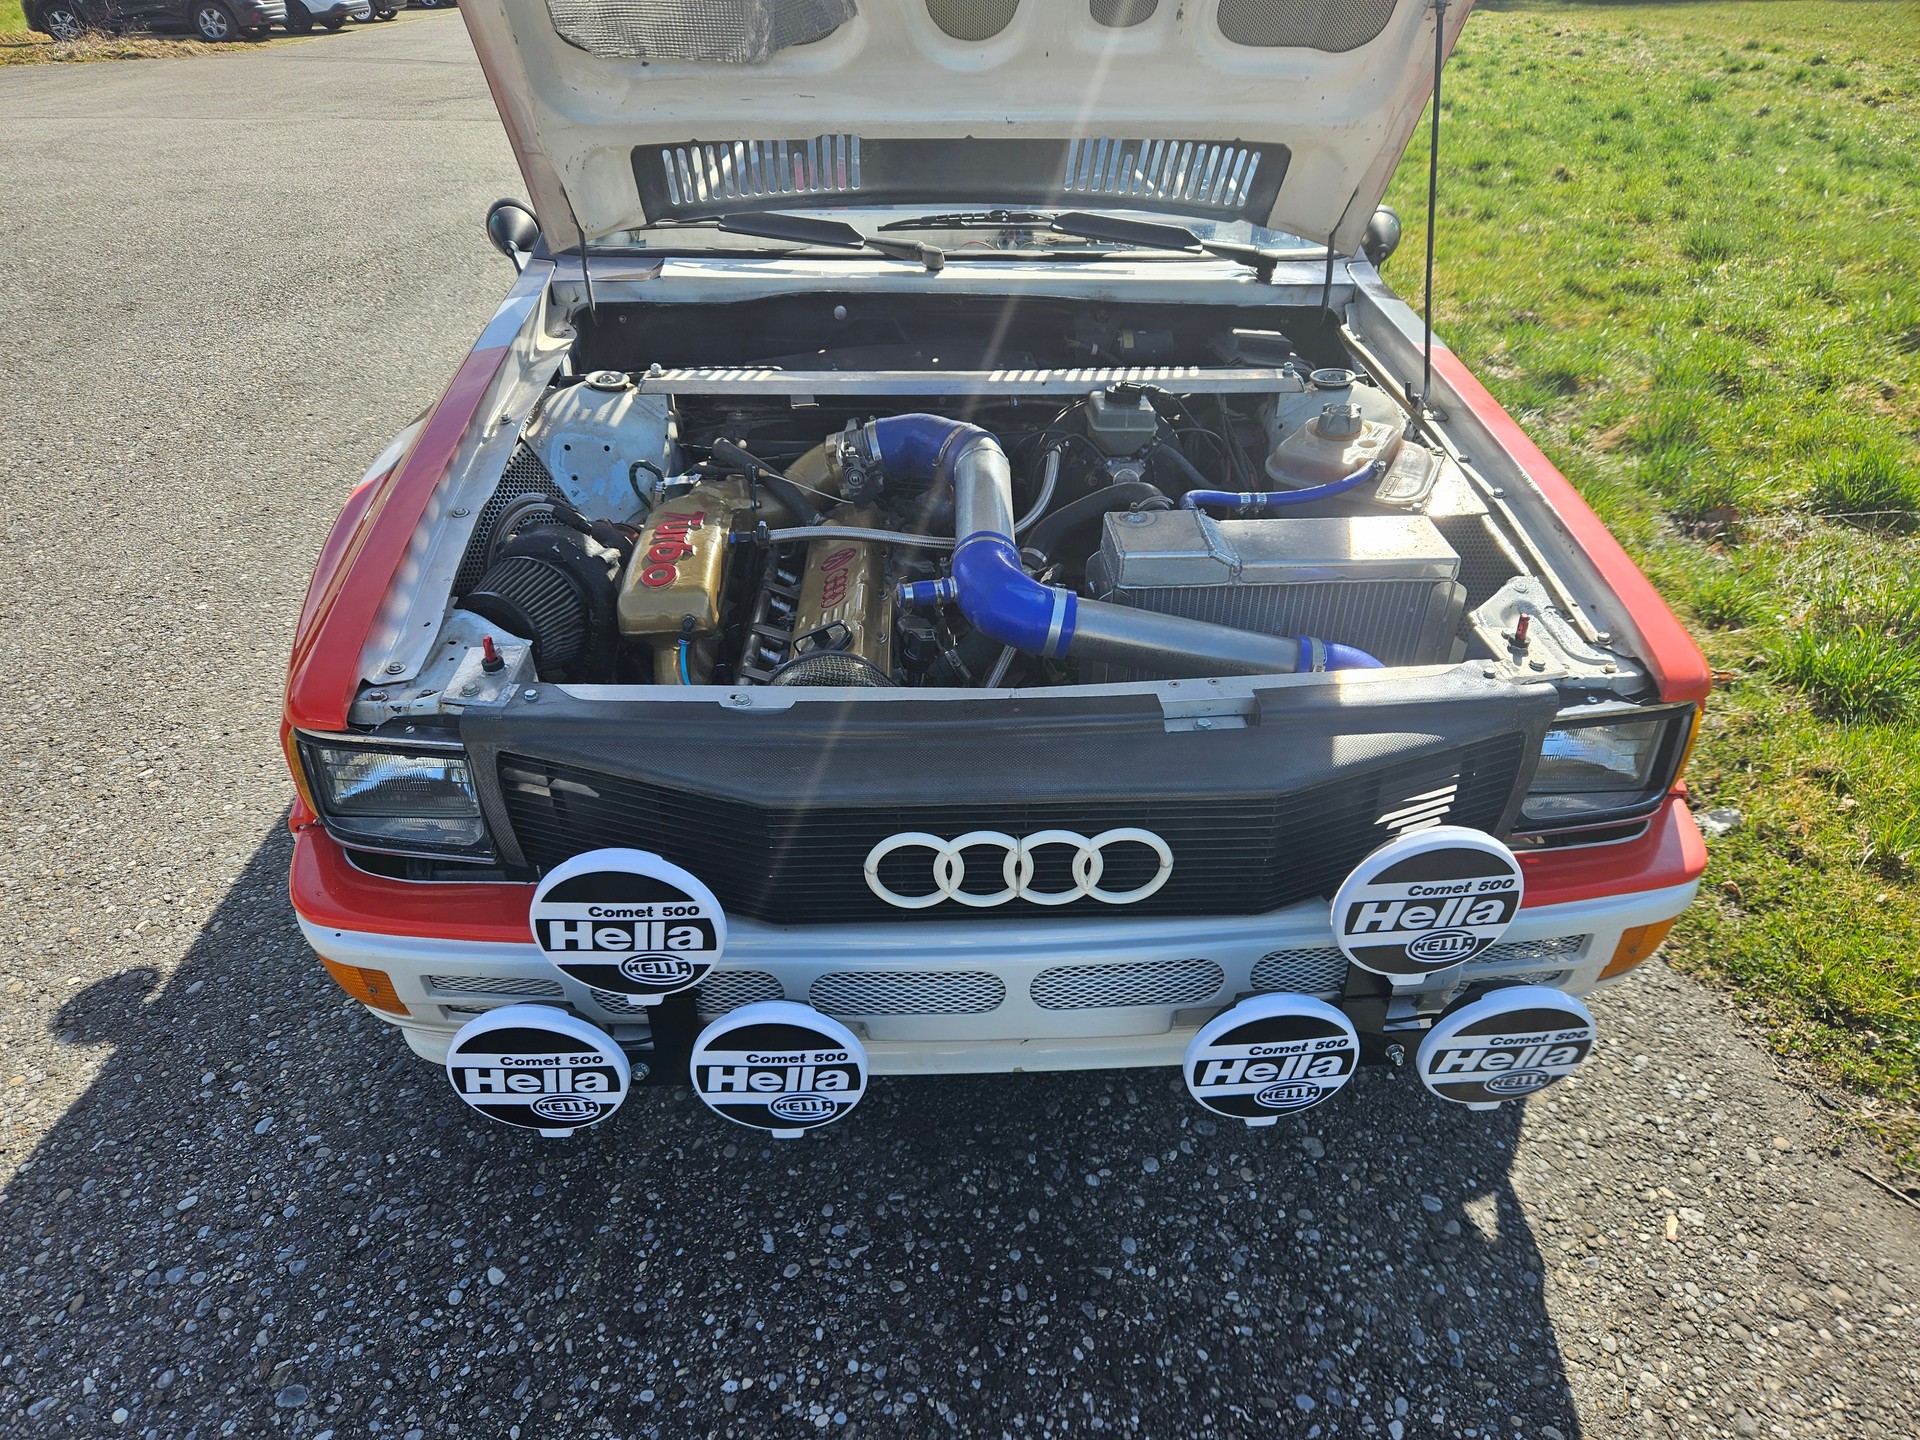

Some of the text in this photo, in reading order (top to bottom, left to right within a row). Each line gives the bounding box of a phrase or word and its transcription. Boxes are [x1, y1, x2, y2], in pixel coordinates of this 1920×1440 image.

[641, 511, 706, 588] Turbo
[1408, 879, 1515, 896] Comet 500
[588, 906, 700, 917] Comet 500
[1351, 896, 1505, 934] Hella
[549, 920, 704, 950] Hella
[1414, 936, 1477, 952] HELLA
[626, 961, 693, 976] HELLA
[1490, 1030, 1589, 1046] Comet 500
[1249, 1038, 1349, 1056] Comet 500
[500, 1055, 604, 1066] Comet 500
[746, 1052, 848, 1064] Comet 500
[1435, 1045, 1579, 1074] Hella
[1200, 1054, 1343, 1086] Hella
[464, 1068, 609, 1094] Hella
[707, 1066, 850, 1093] Hella
[1490, 1073, 1551, 1087] HELLA
[1261, 1086, 1320, 1099] HELLA
[538, 1102, 599, 1113] HELLA
[775, 1101, 835, 1112] HELLA
